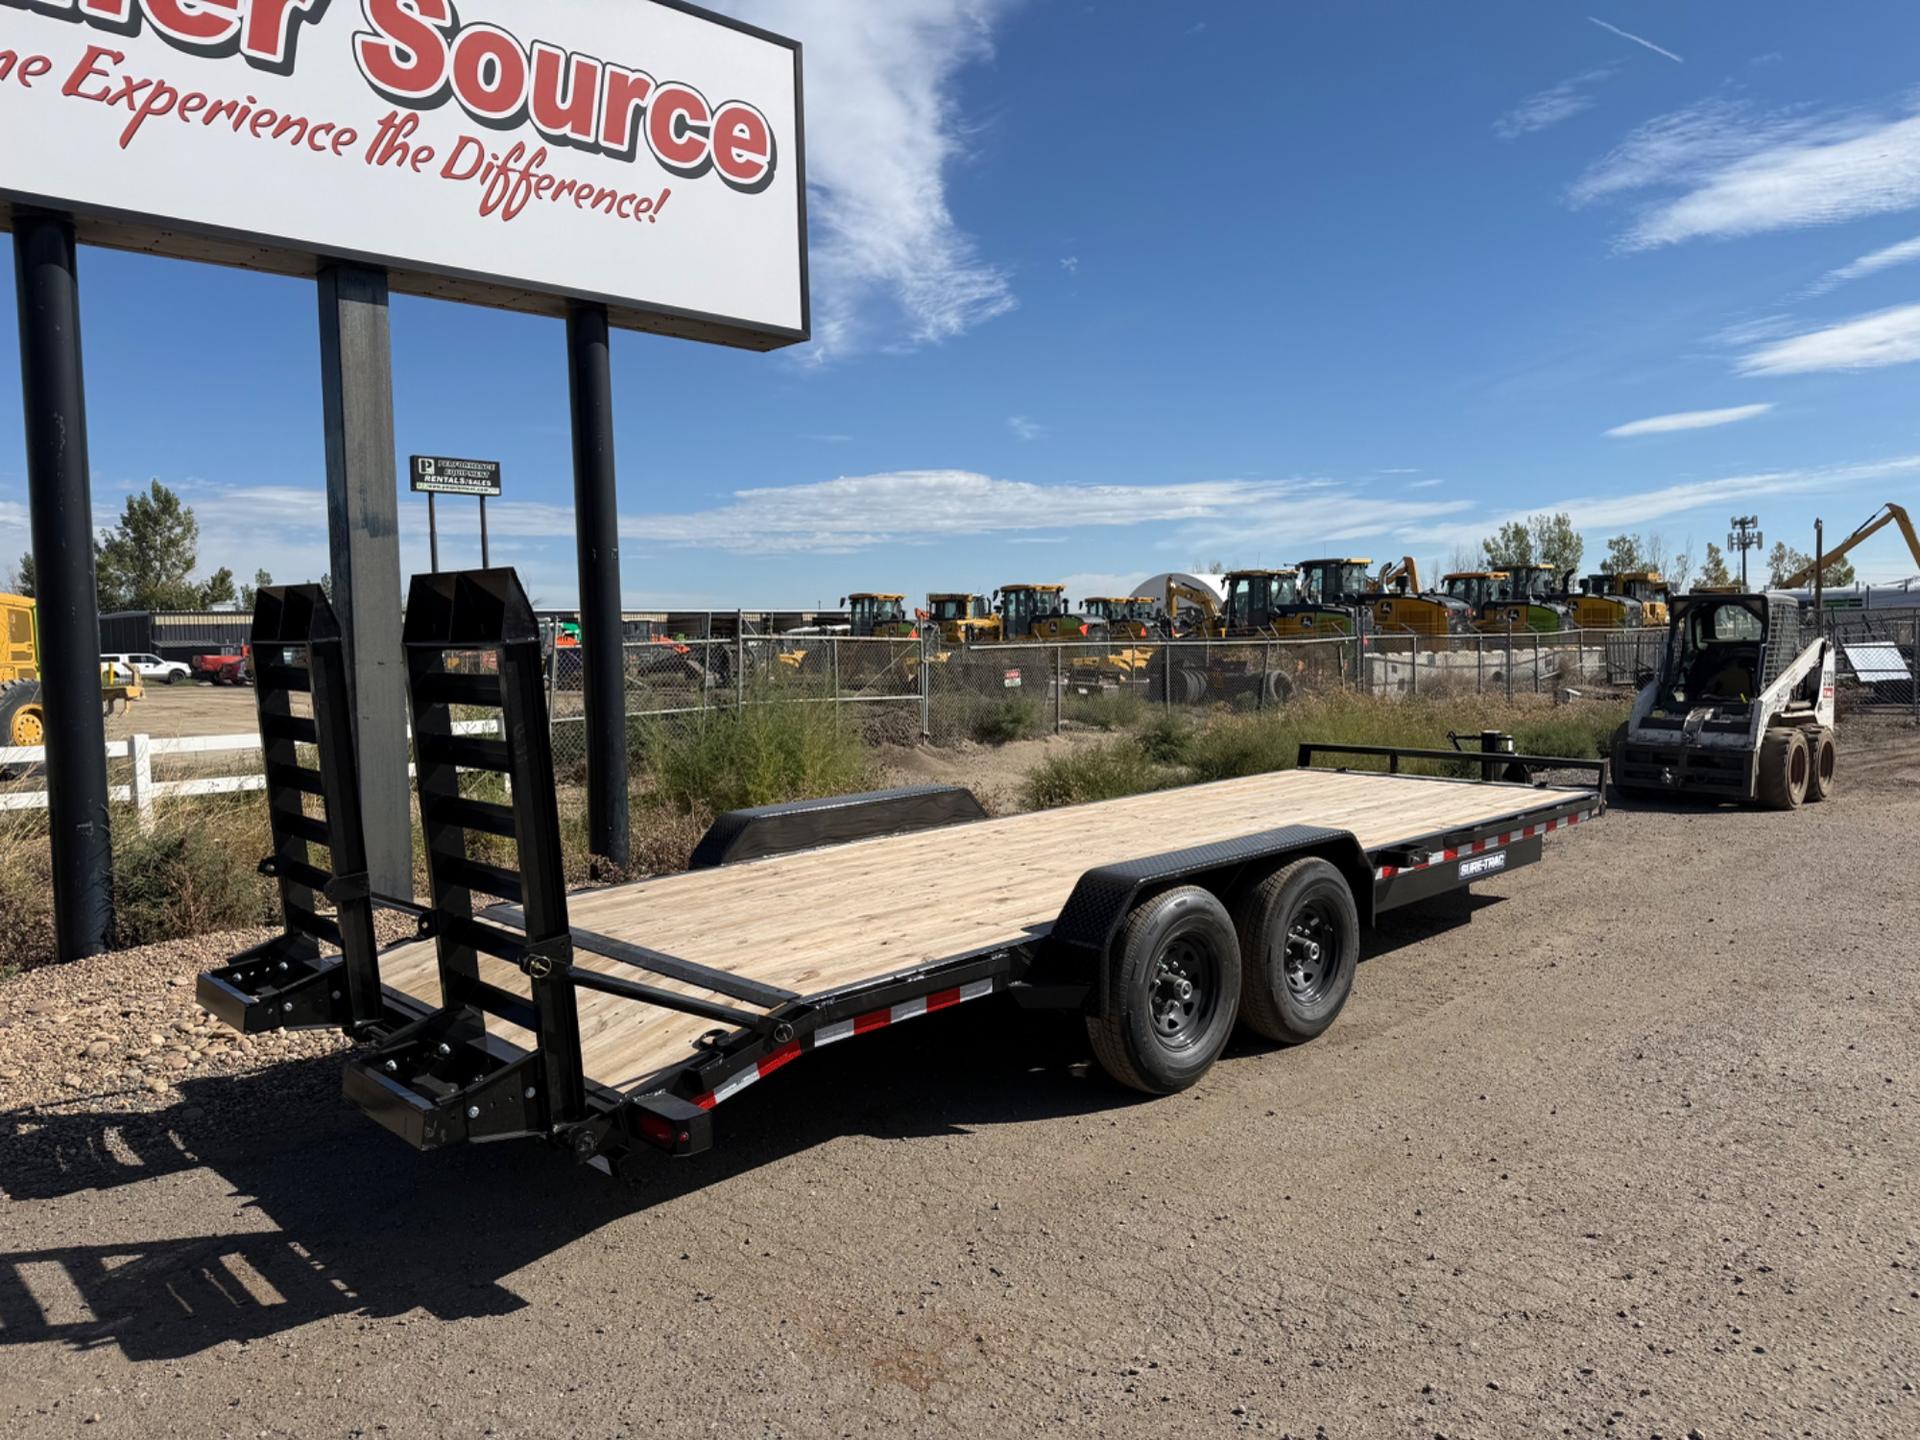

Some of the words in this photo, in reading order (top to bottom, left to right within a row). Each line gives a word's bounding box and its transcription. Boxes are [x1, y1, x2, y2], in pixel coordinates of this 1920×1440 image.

[61, 44, 358, 156] Experience
[365, 110, 435, 173] the
[439, 135, 671, 223] Difference!
[350, 0, 777, 194] Source
